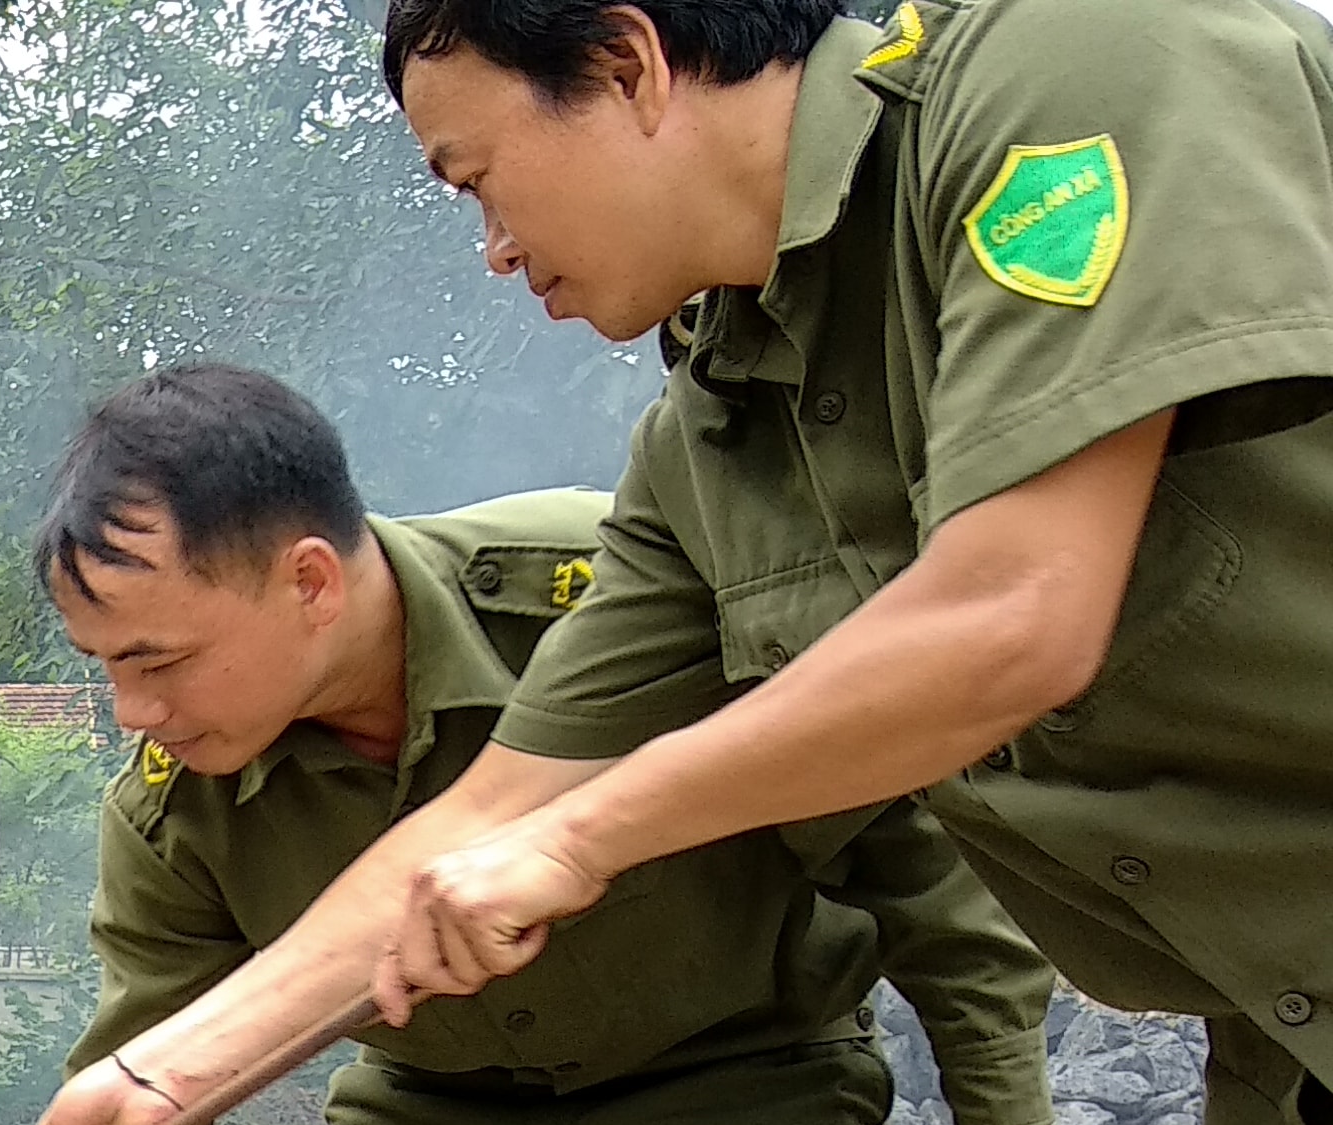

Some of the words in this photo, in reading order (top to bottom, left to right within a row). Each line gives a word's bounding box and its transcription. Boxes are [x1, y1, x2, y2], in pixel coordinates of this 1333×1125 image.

[990, 201, 1046, 245] CÔNG
[1042, 181, 1076, 212] AN
[1070, 165, 1103, 197] XÃ
